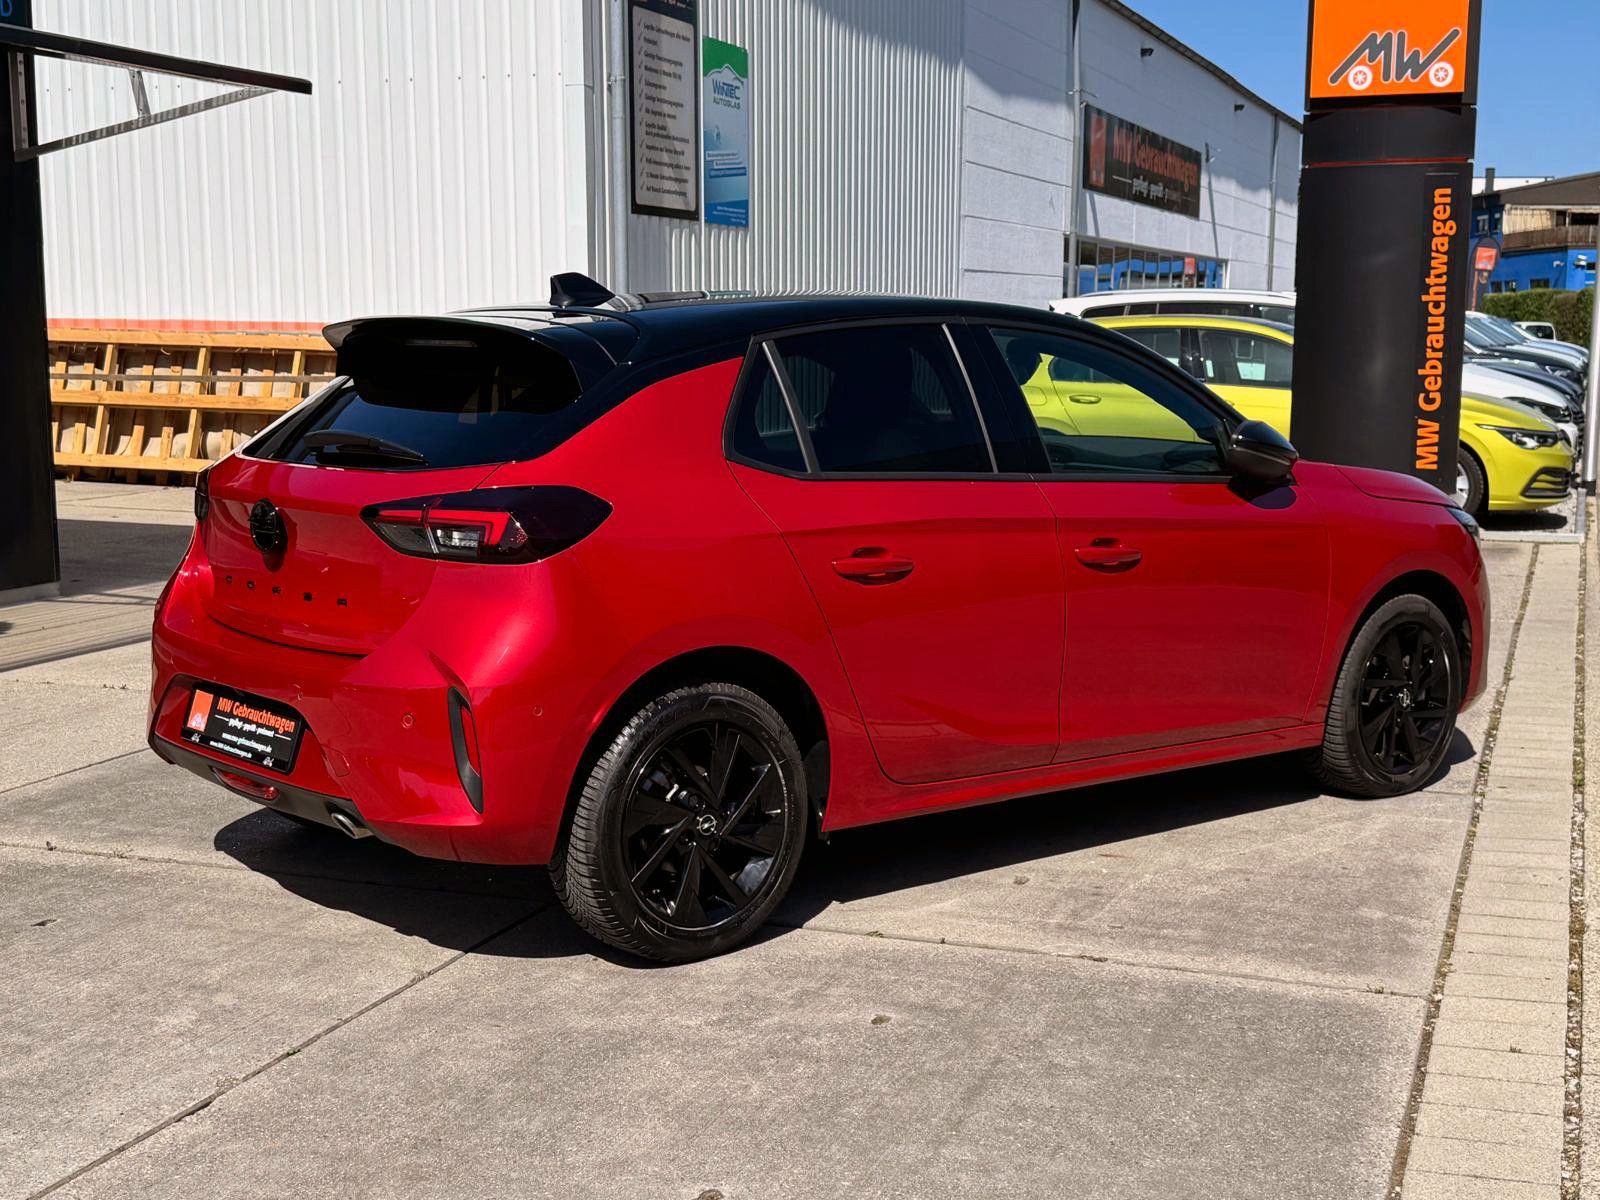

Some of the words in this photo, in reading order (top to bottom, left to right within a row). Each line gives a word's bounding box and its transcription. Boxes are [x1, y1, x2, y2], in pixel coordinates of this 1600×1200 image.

[1328, 27, 1462, 86] MW
[713, 96, 741, 110] AUTOGLAS
[1136, 133, 1198, 193] Gebrauchtwagen
[1418, 188, 1457, 412] Gebrauchtwagen
[1415, 419, 1440, 470] MW
[217, 696, 234, 713] MW
[232, 701, 296, 734] Gebrauchtwagen
